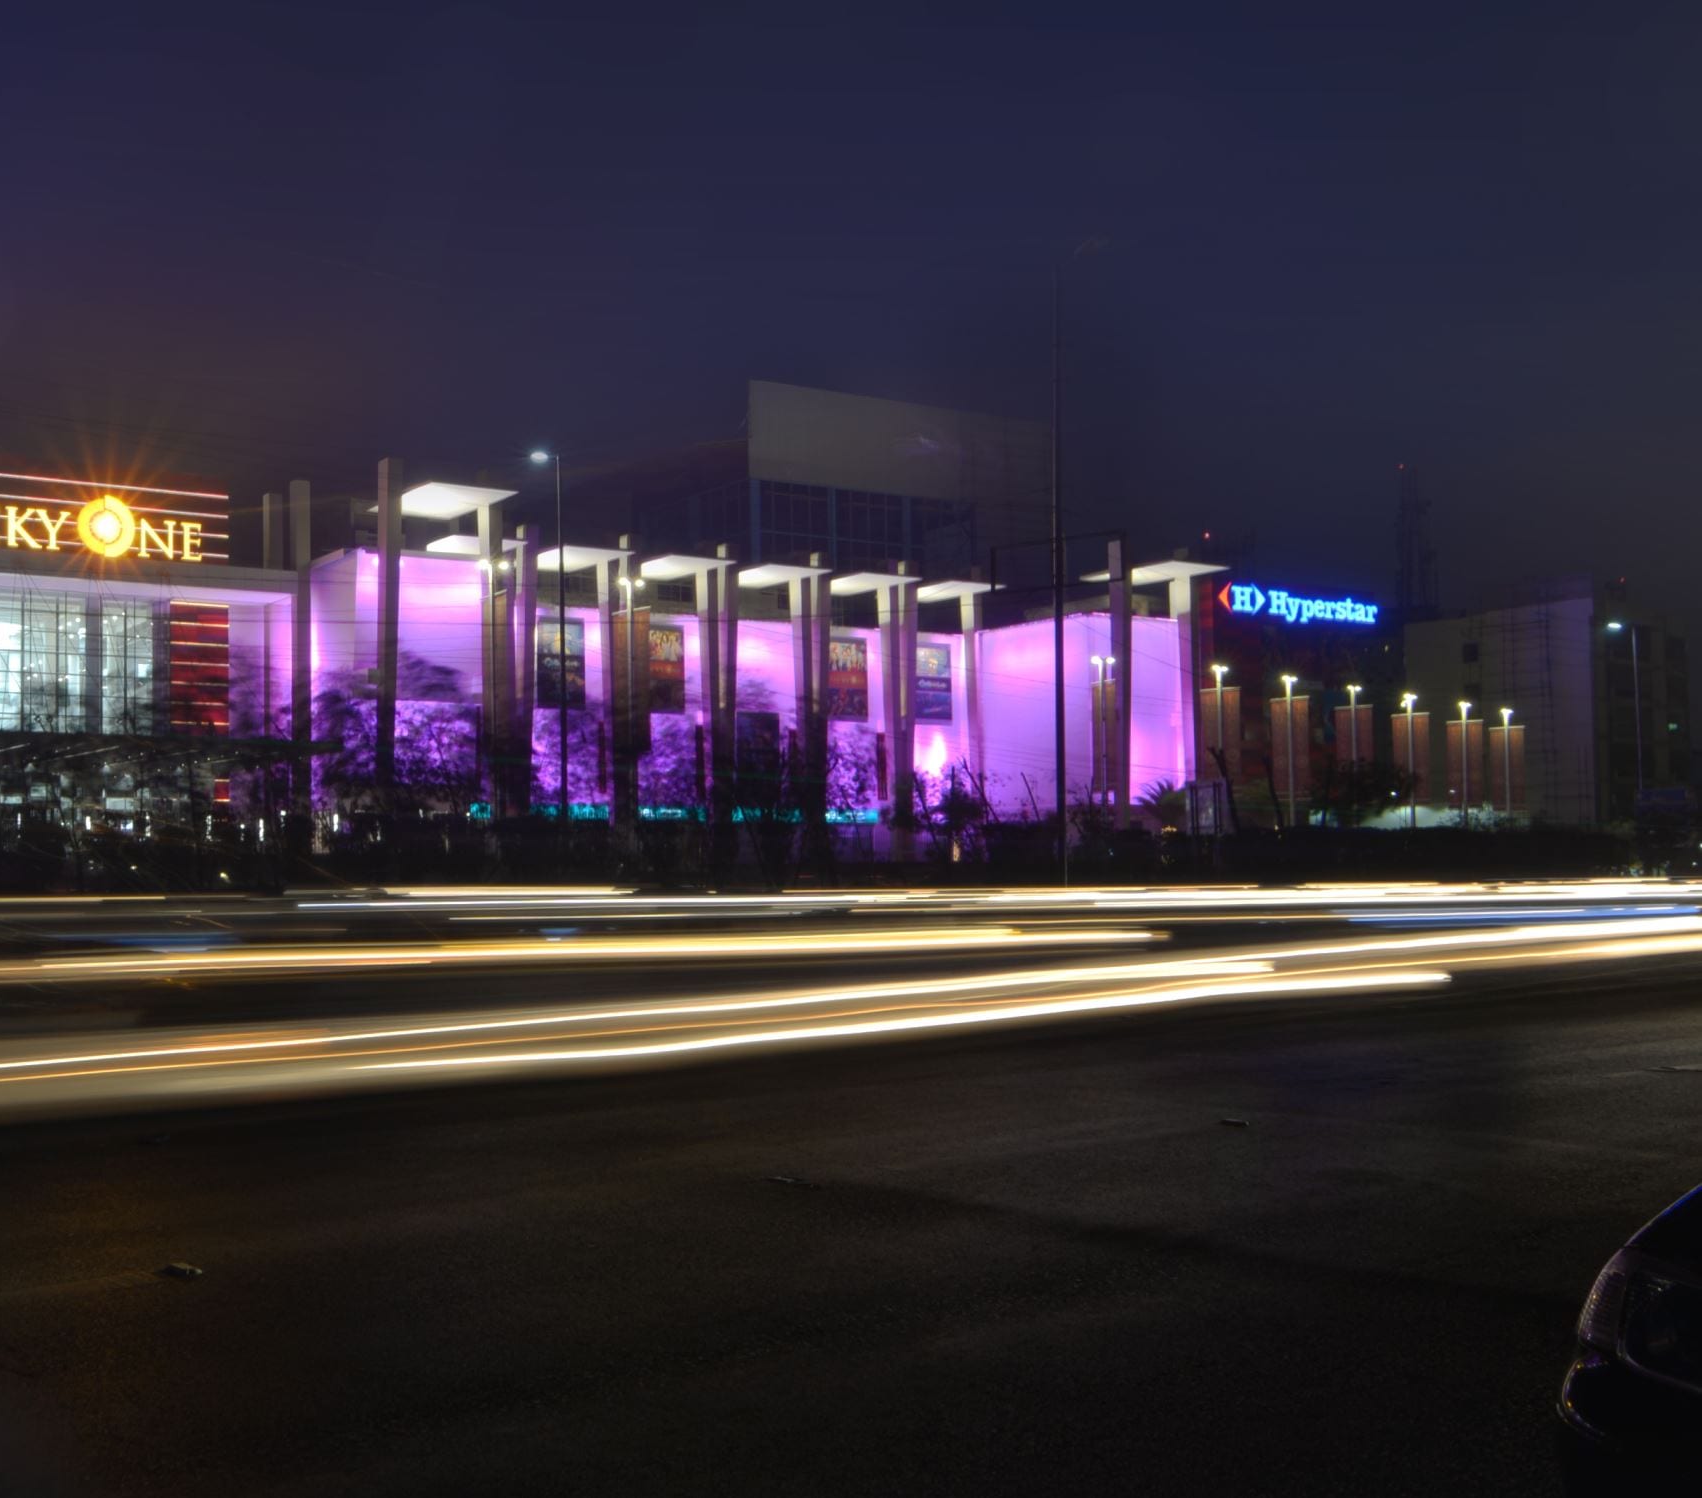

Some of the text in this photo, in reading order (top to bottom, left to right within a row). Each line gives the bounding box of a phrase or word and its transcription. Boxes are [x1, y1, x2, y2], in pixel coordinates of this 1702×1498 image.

[78, 494, 203, 562] ONE
[1231, 585, 1378, 623] H Hyperstar
